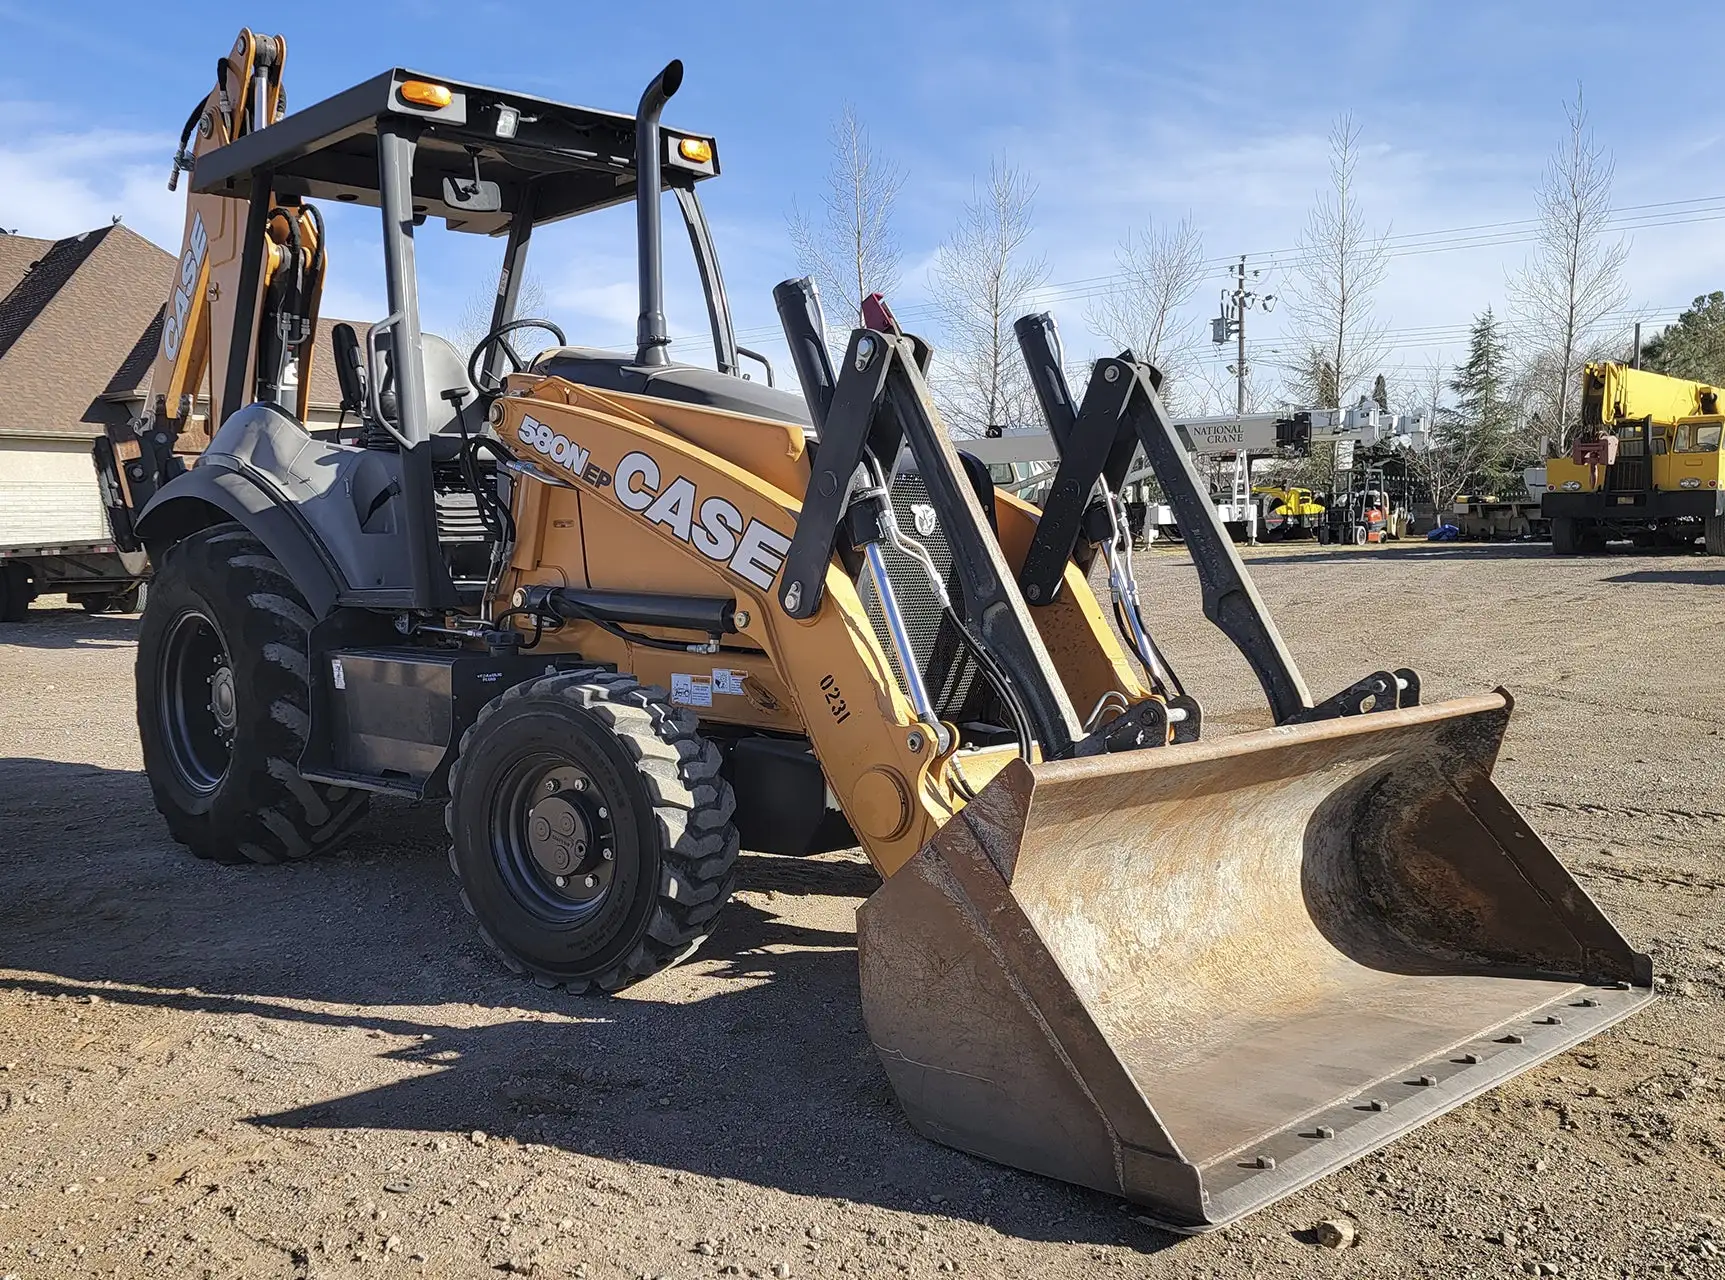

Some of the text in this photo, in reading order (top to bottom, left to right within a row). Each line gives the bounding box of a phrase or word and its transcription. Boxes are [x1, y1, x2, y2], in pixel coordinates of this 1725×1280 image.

[164, 210, 207, 361] CASE
[1193, 424, 1244, 436] NATIONAL
[1207, 433, 1244, 444] CRANE
[613, 451, 793, 592] CASE
[820, 674, 851, 725] 0231
